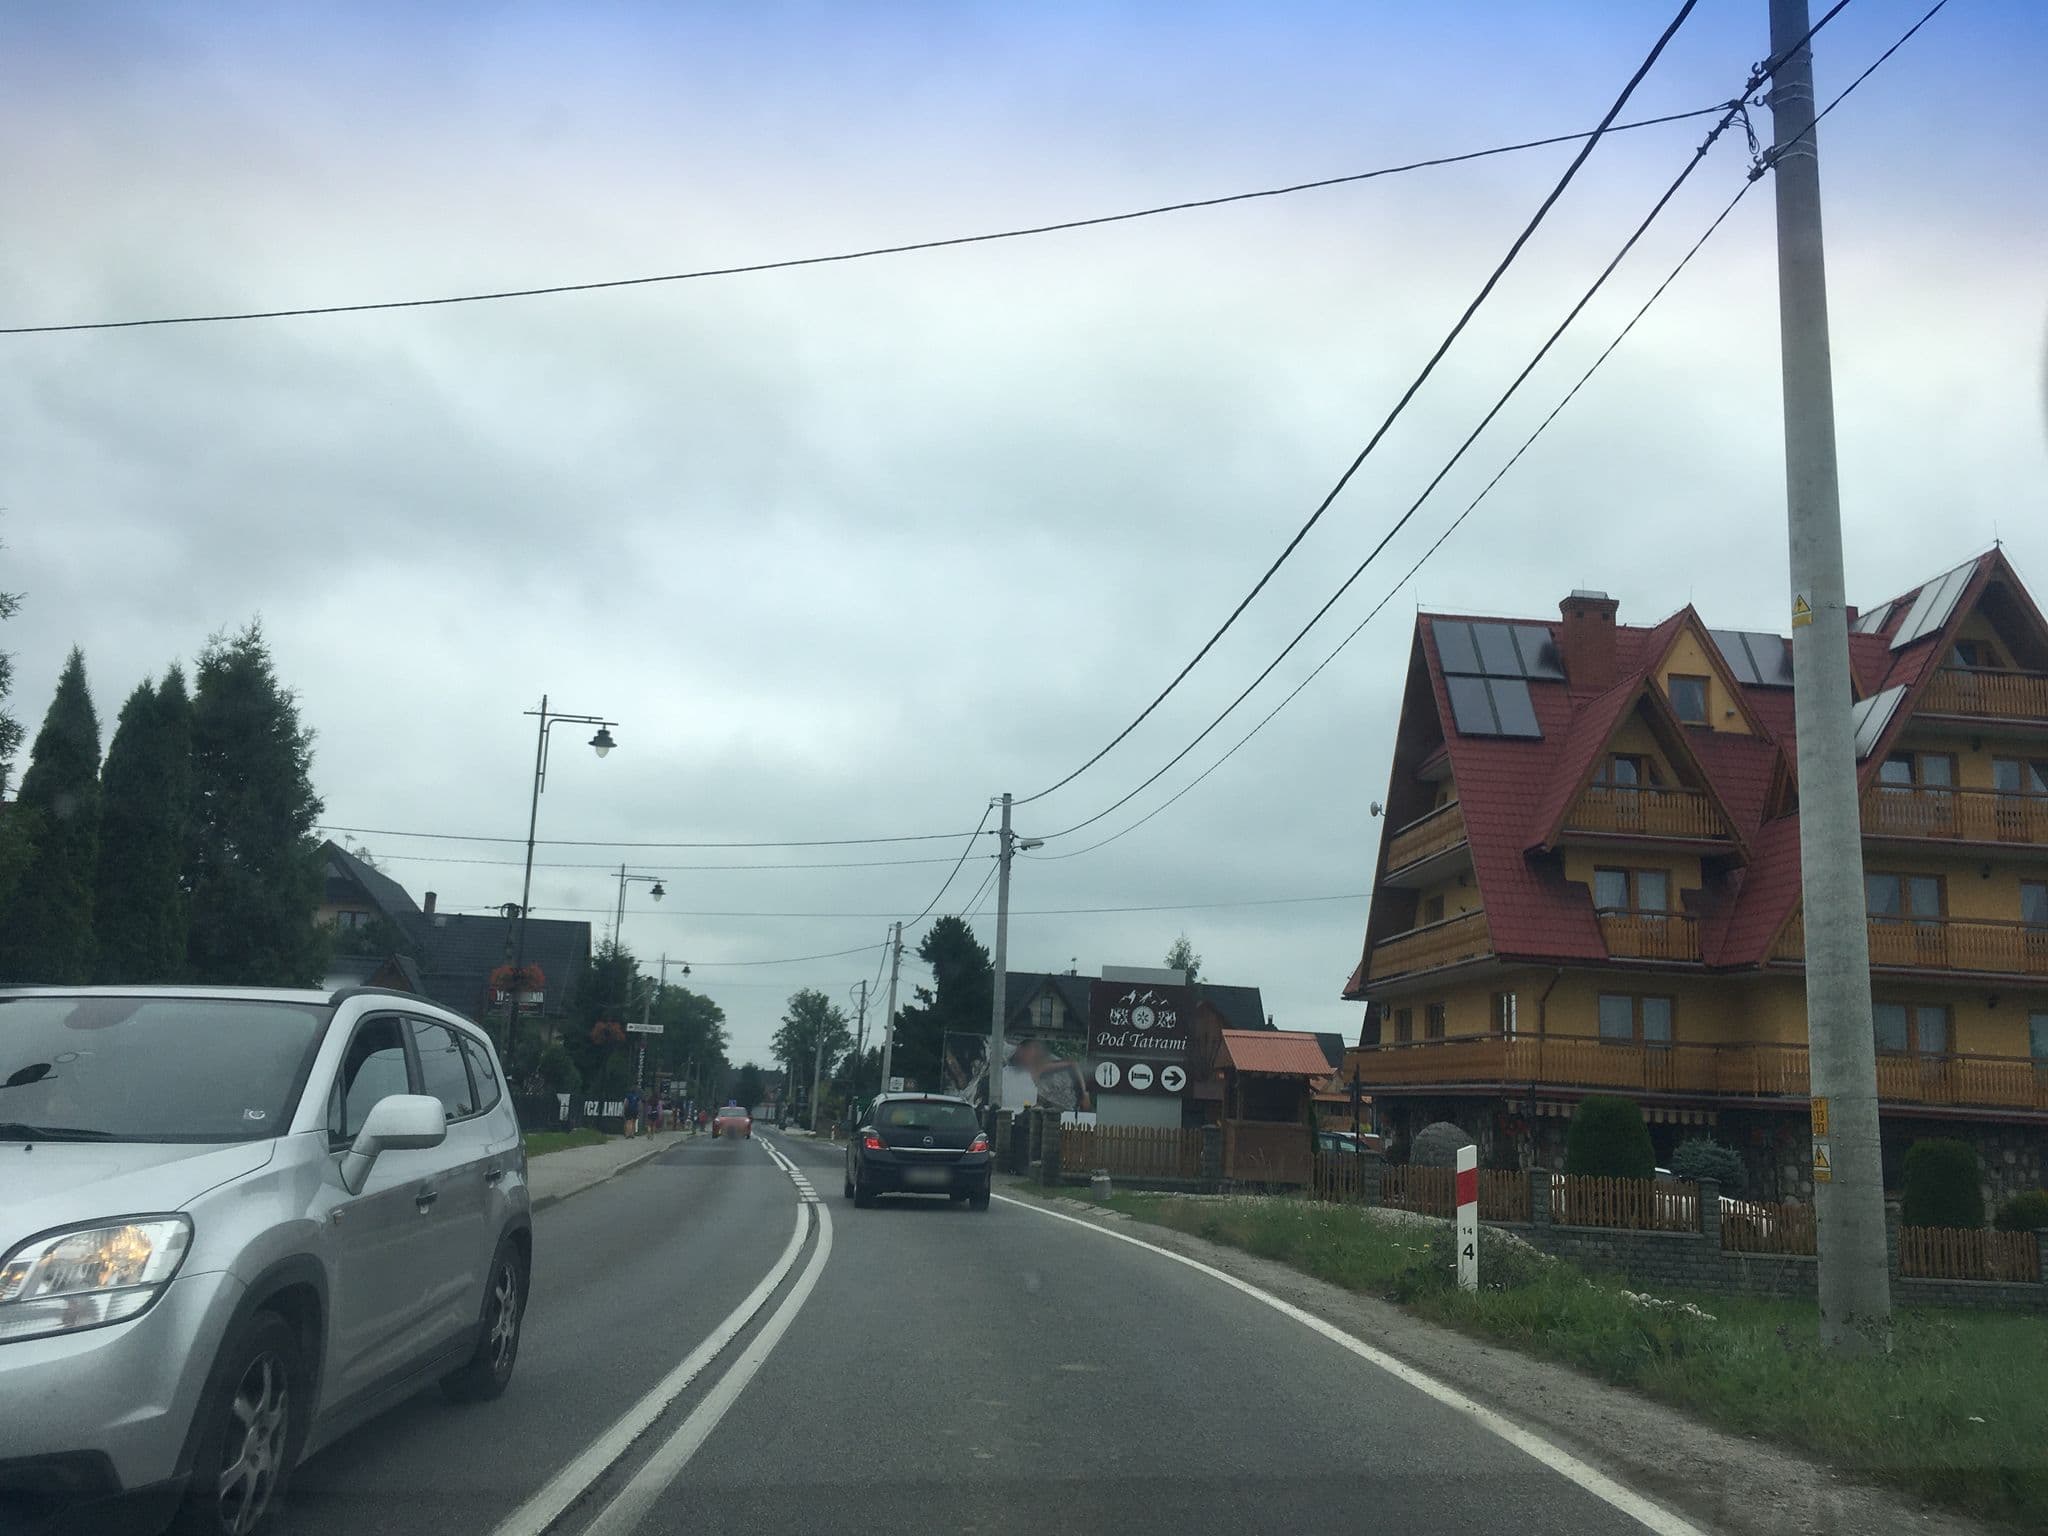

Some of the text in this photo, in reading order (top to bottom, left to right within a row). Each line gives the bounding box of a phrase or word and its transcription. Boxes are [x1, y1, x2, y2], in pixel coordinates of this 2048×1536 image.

[1097, 1031, 1188, 1050] Pod Tatrami
[1462, 1227, 1473, 1235] 14
[1463, 1243, 1474, 1260] 4
